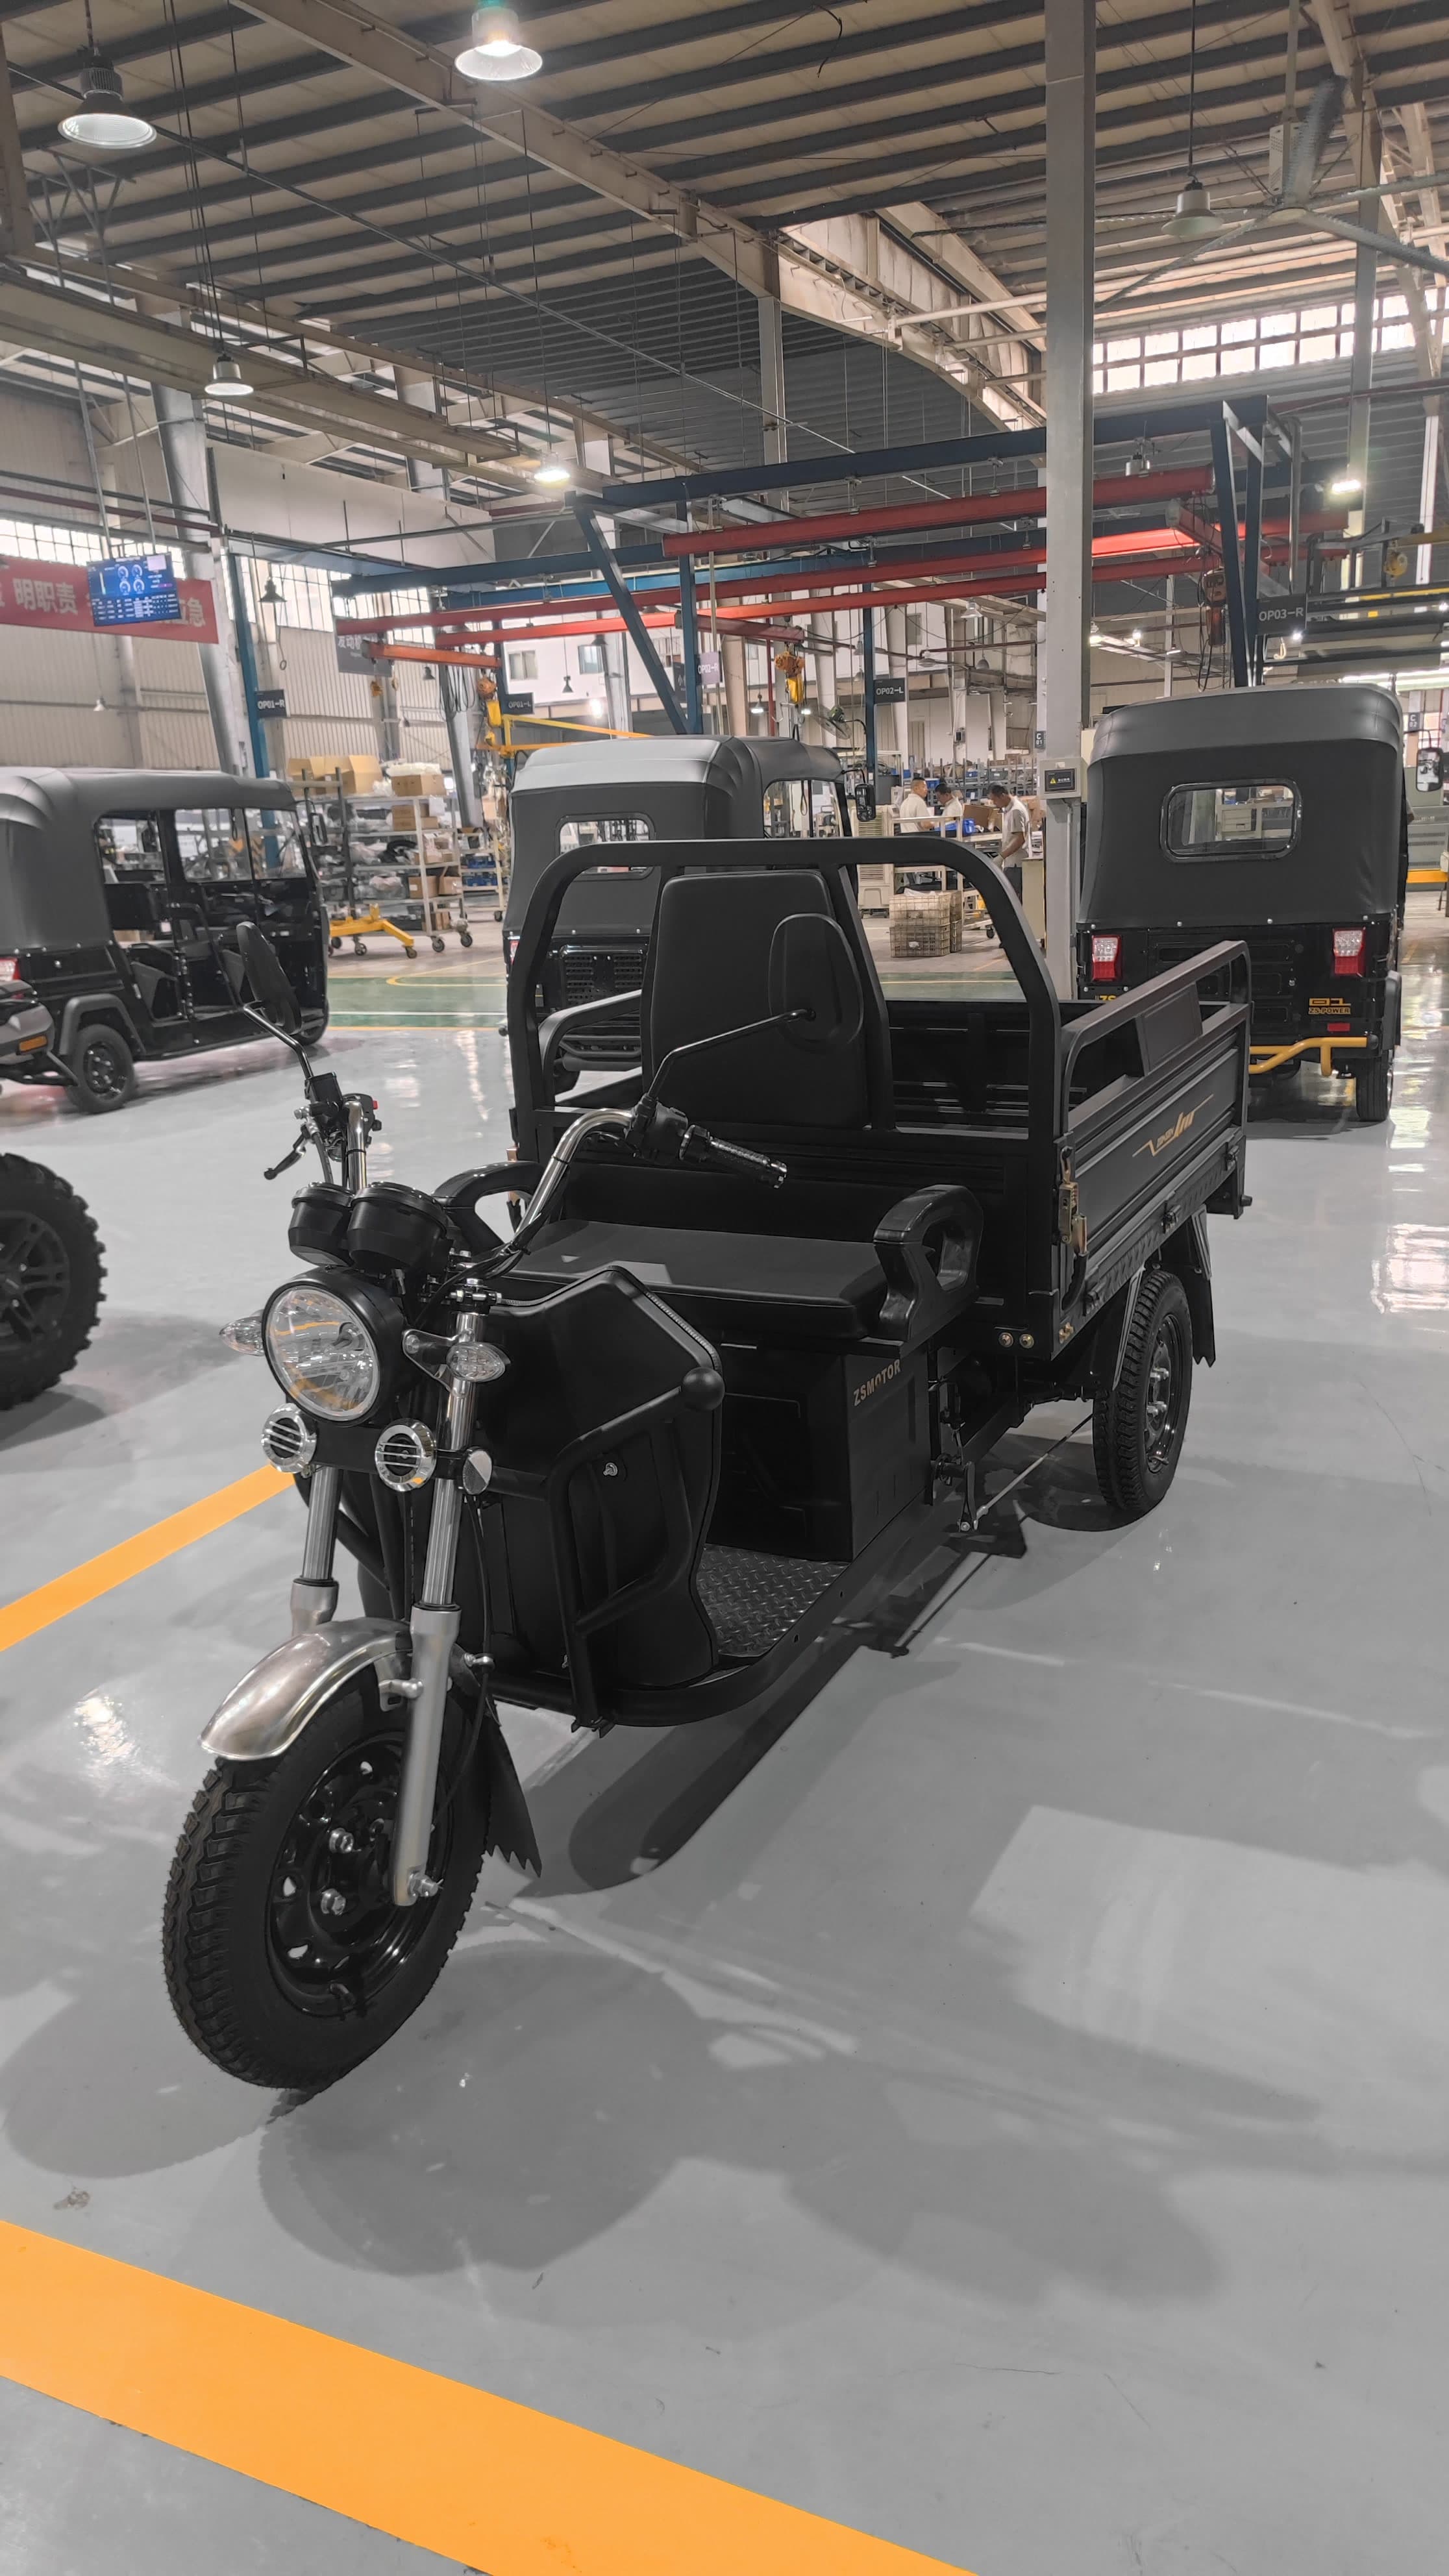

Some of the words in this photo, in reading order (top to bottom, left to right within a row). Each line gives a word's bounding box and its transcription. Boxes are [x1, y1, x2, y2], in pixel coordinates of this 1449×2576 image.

[0, 578, 78, 615] 明职责
[1259, 607, 1304, 621] OP03-R
[876, 687, 904, 695] OP02-L
[853, 1359, 900, 1406] ZSMOTOR
